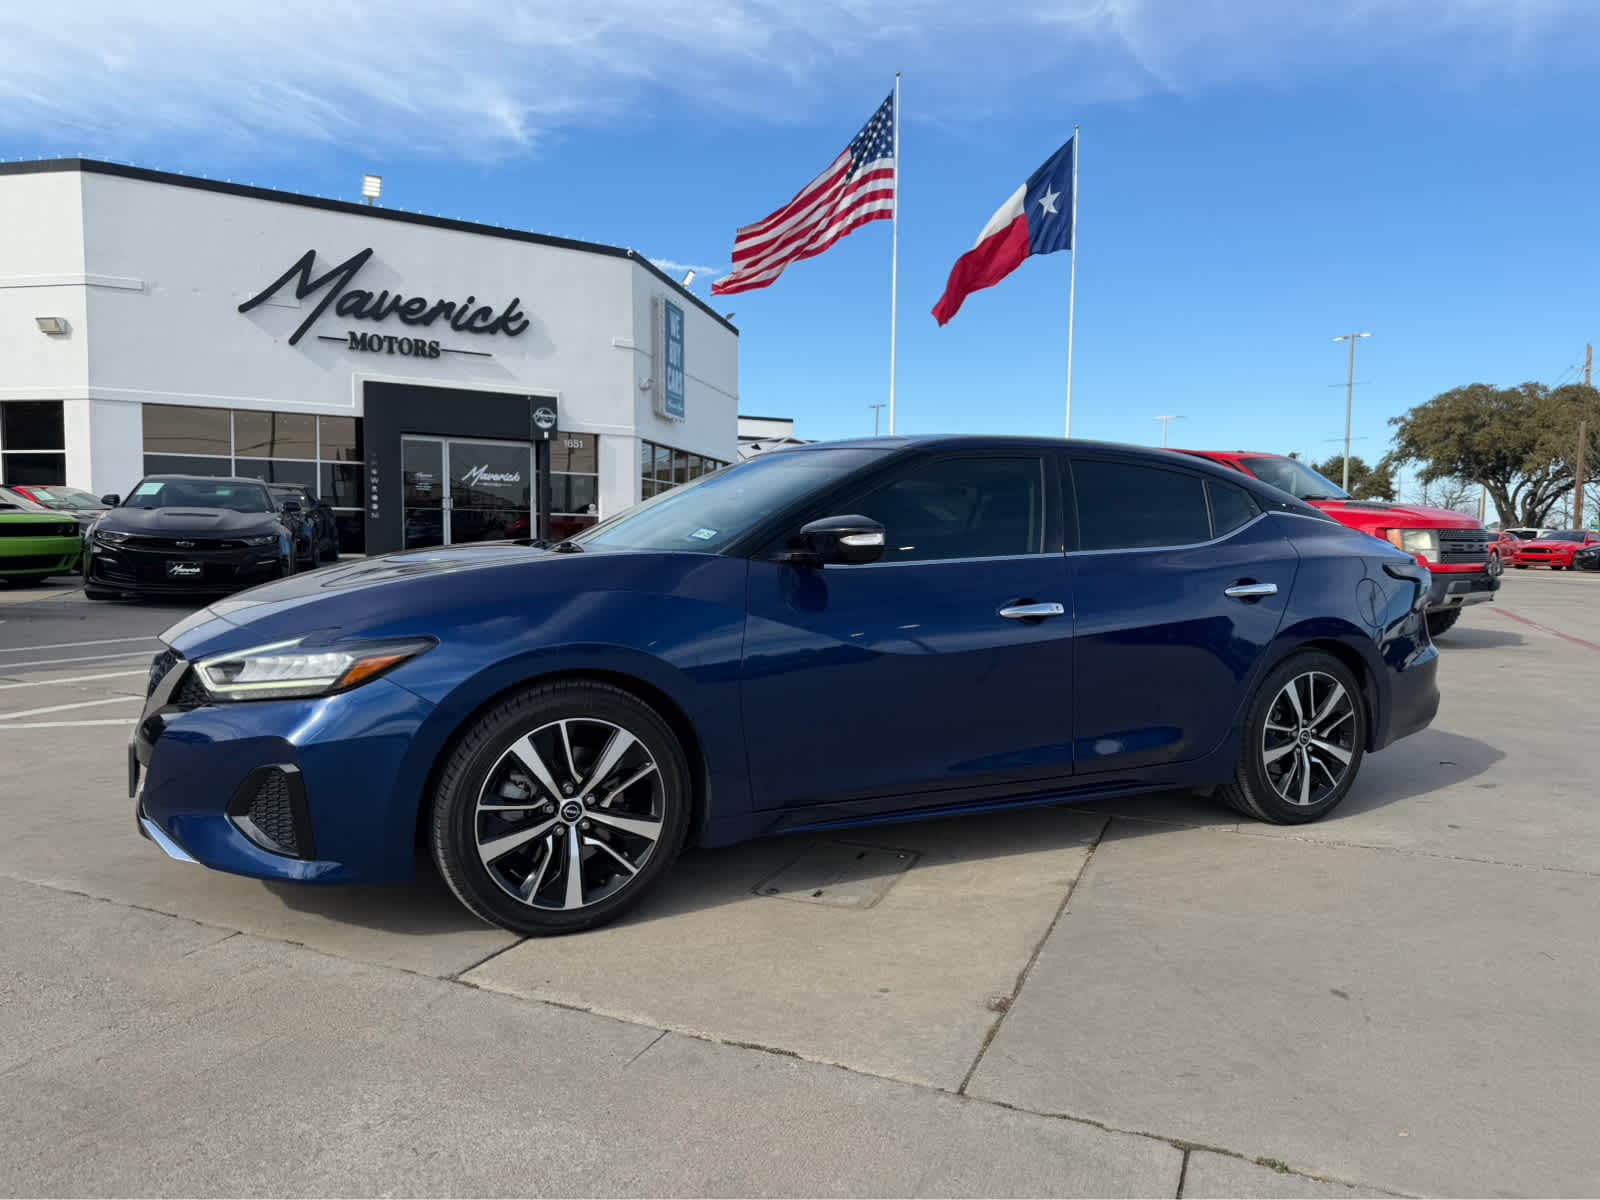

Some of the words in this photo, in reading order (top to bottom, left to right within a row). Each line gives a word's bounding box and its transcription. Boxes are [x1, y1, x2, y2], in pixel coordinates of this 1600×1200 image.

[238, 247, 531, 346] Maverick
[347, 331, 441, 359] MOTORS
[563, 439, 584, 449] 1651
